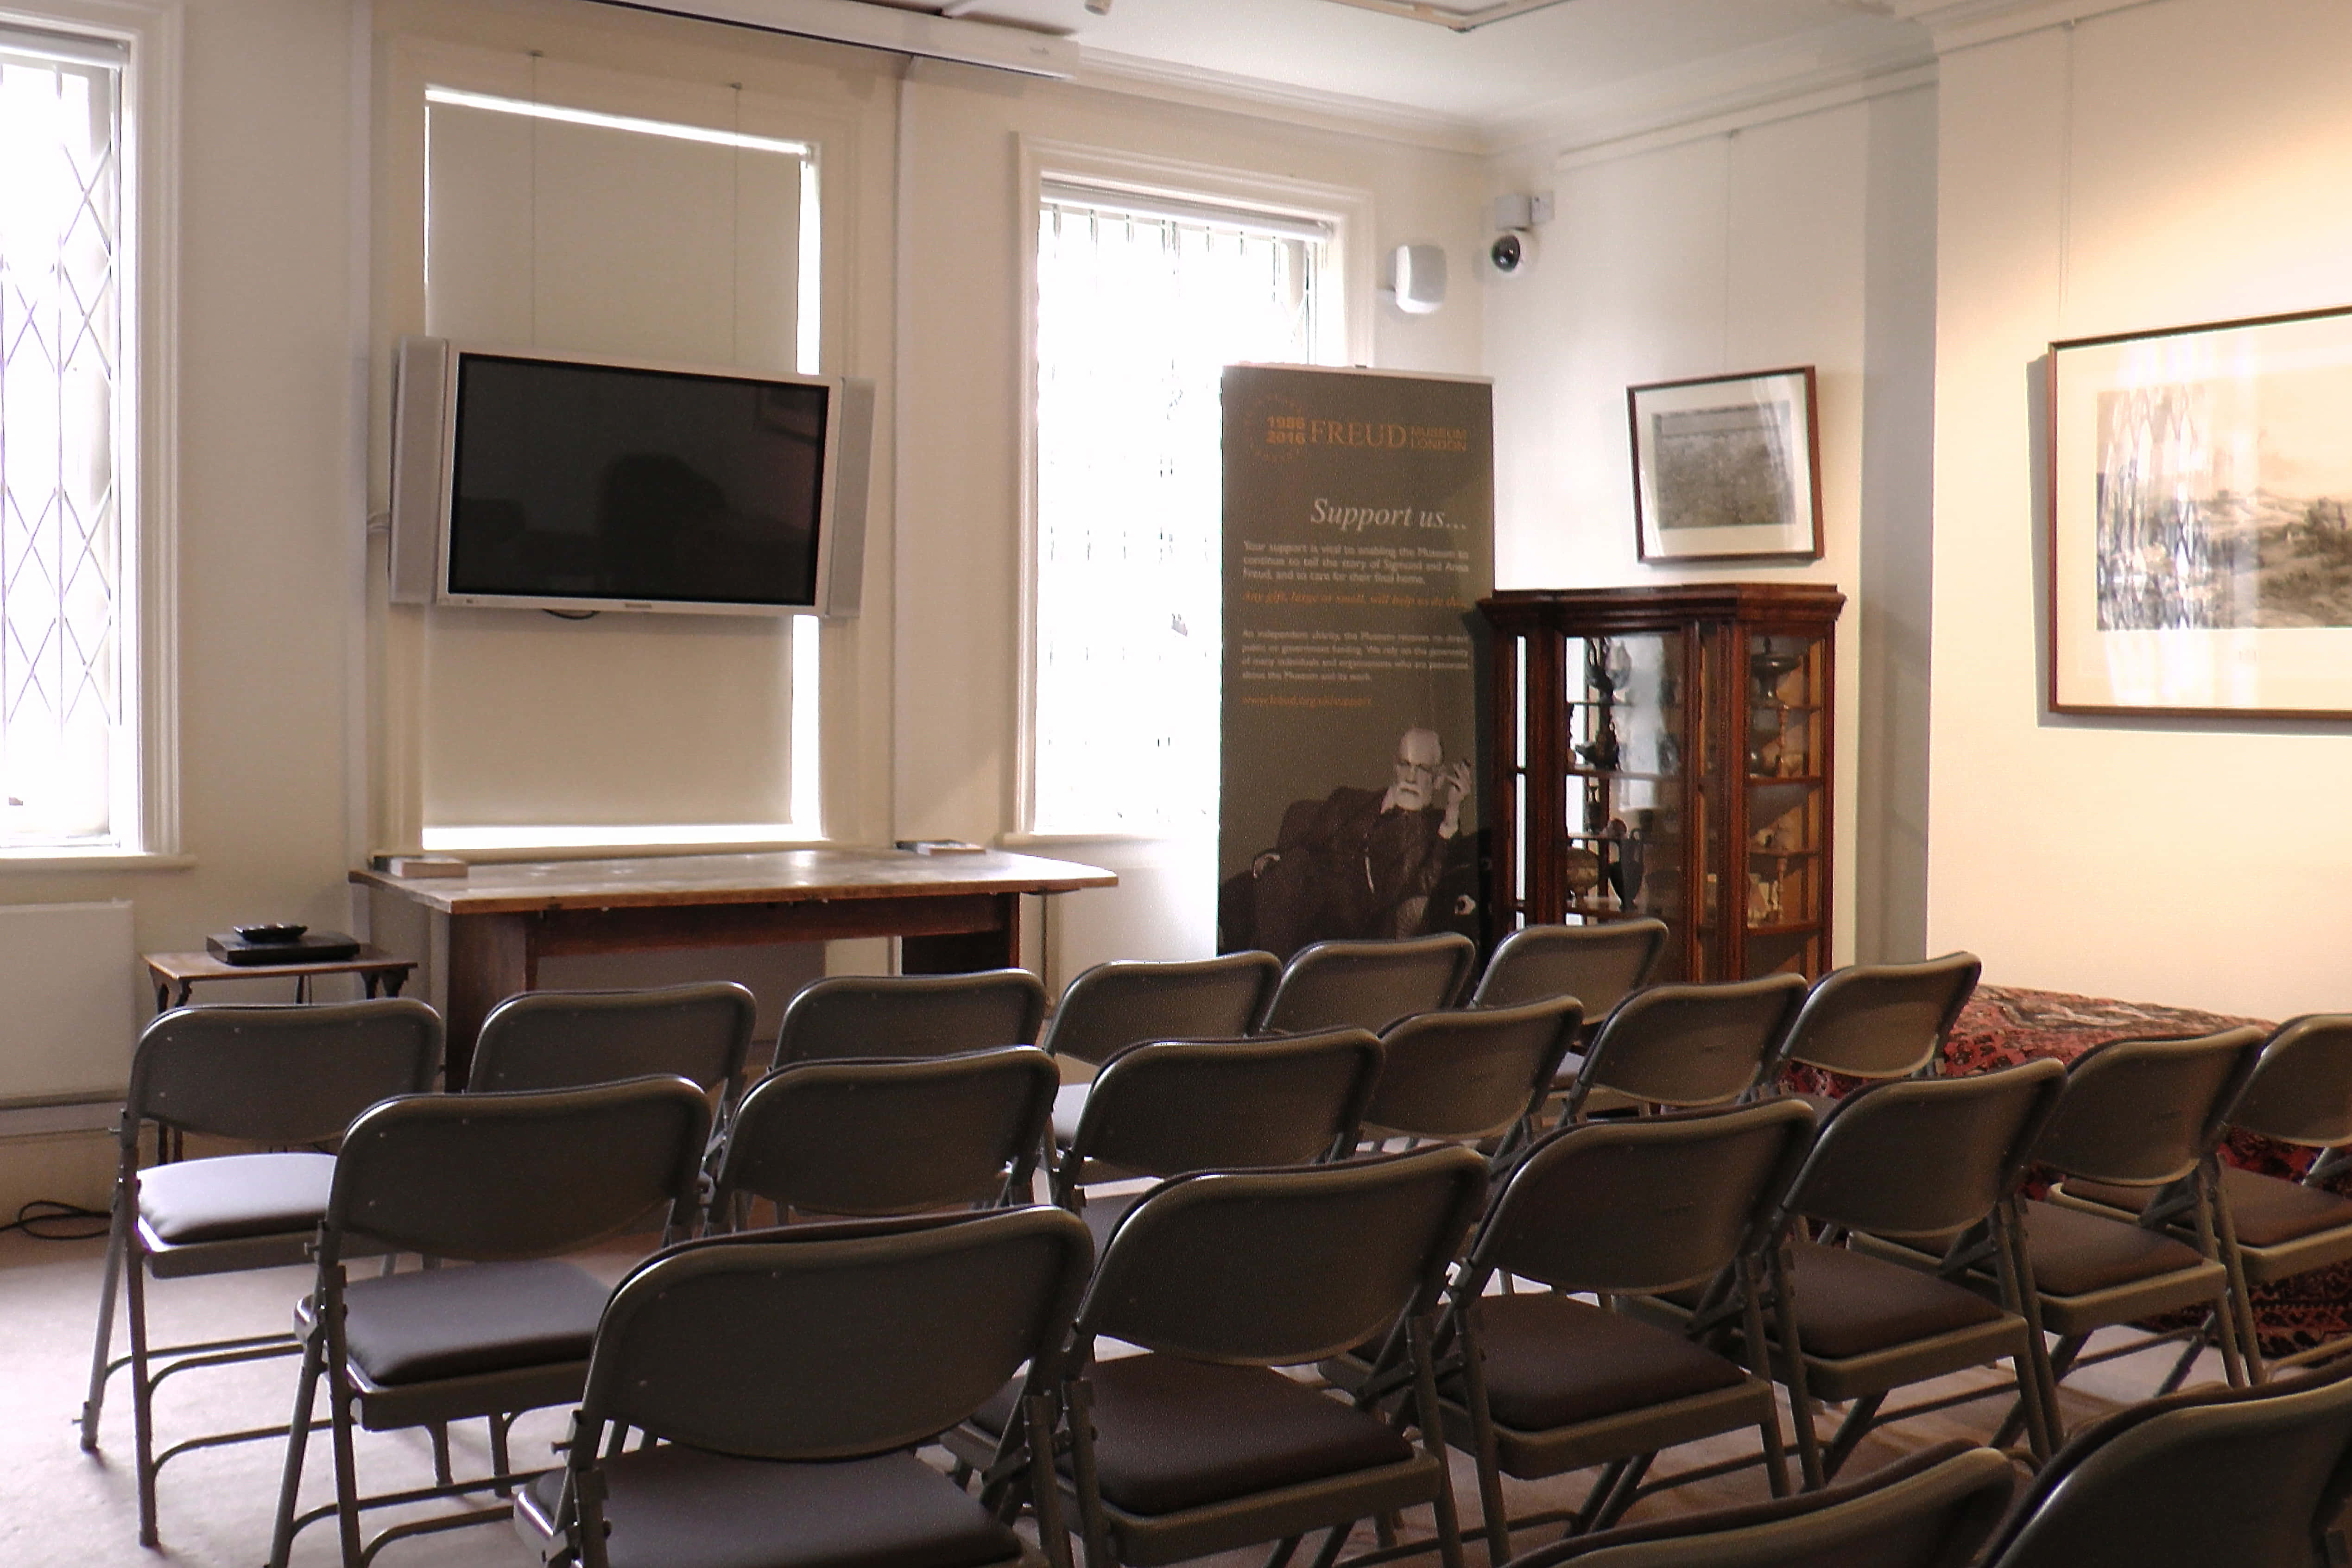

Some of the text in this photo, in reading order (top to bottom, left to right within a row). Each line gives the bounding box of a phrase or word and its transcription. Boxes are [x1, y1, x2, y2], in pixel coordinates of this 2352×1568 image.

[1266, 430, 1305, 445] 2016
[1310, 419, 1407, 449] FREUD
[1410, 426, 1467, 438] MUSEUM
[1410, 437, 1467, 452] LONDON
[1310, 498, 1467, 531] Support us...
